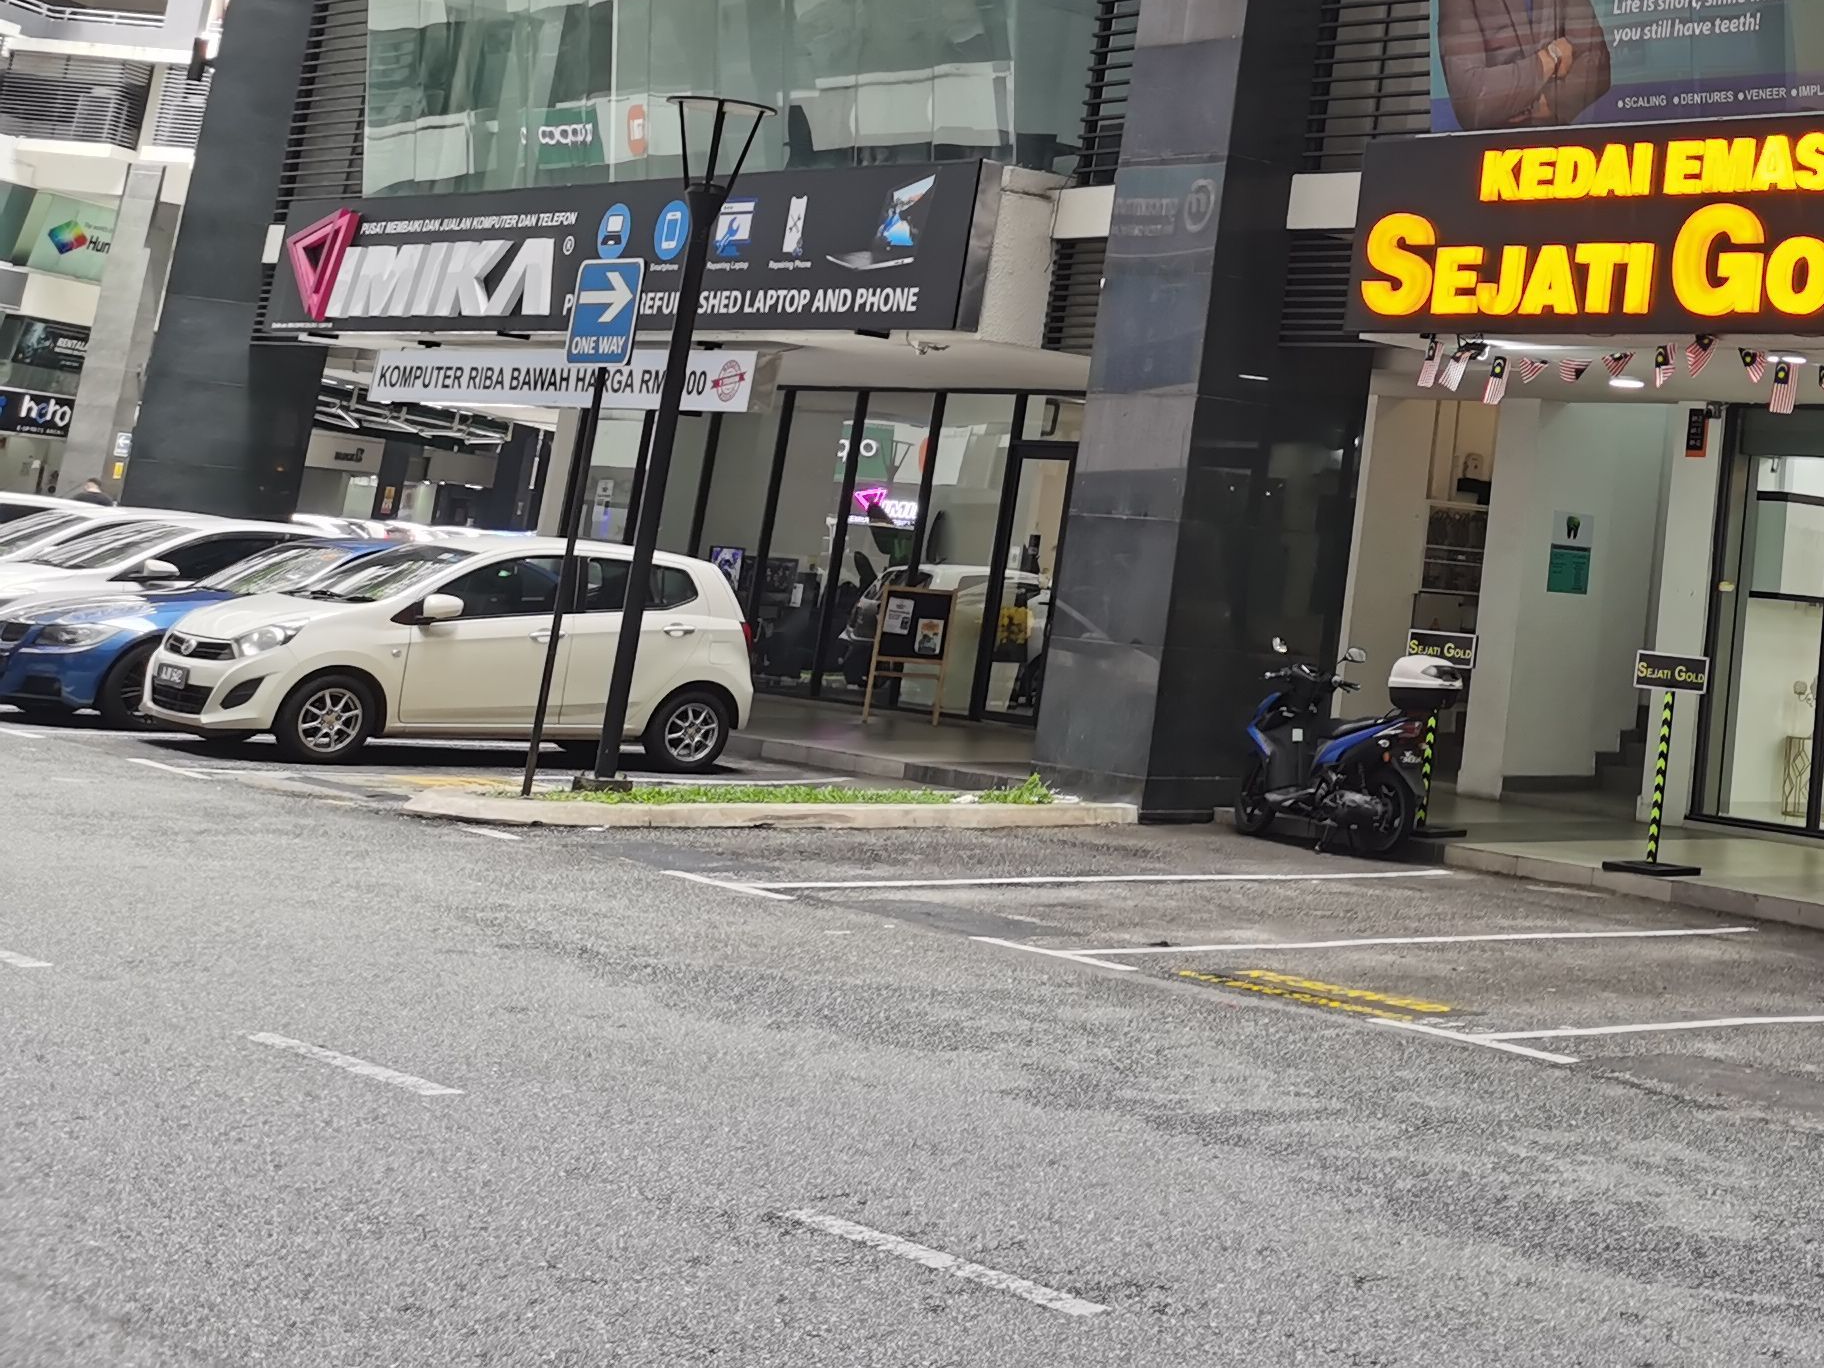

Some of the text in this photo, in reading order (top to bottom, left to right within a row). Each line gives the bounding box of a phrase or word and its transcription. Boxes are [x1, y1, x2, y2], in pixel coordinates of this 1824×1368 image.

[1612, 12, 1762, 47] you still have teeth!
[1624, 95, 1667, 108] SCALING
[1680, 90, 1734, 105] DENTURES
[1745, 87, 1787, 101] VENEER
[1479, 140, 1652, 202] KEDAI
[360, 211, 578, 235] PUSAT MEMBAIKI DAN JUALAN KOMPUTER DAN TELEFON
[706, 261, 749, 272] Repairing Laptop
[793, 260, 811, 270] Phone
[1360, 212, 1657, 317] SEJATI
[744, 287, 809, 314] LAPTOP
[811, 287, 851, 313] AND
[854, 286, 919, 313] PHONE
[571, 335, 626, 355] ONE WAY
[377, 365, 634, 394] KOMPUTER RIBA BAWAH HARGA
[19, 394, 71, 427] hero
[1409, 639, 1472, 659] SEJATI GOLD
[1637, 662, 1705, 683] SEJATI GOLD
